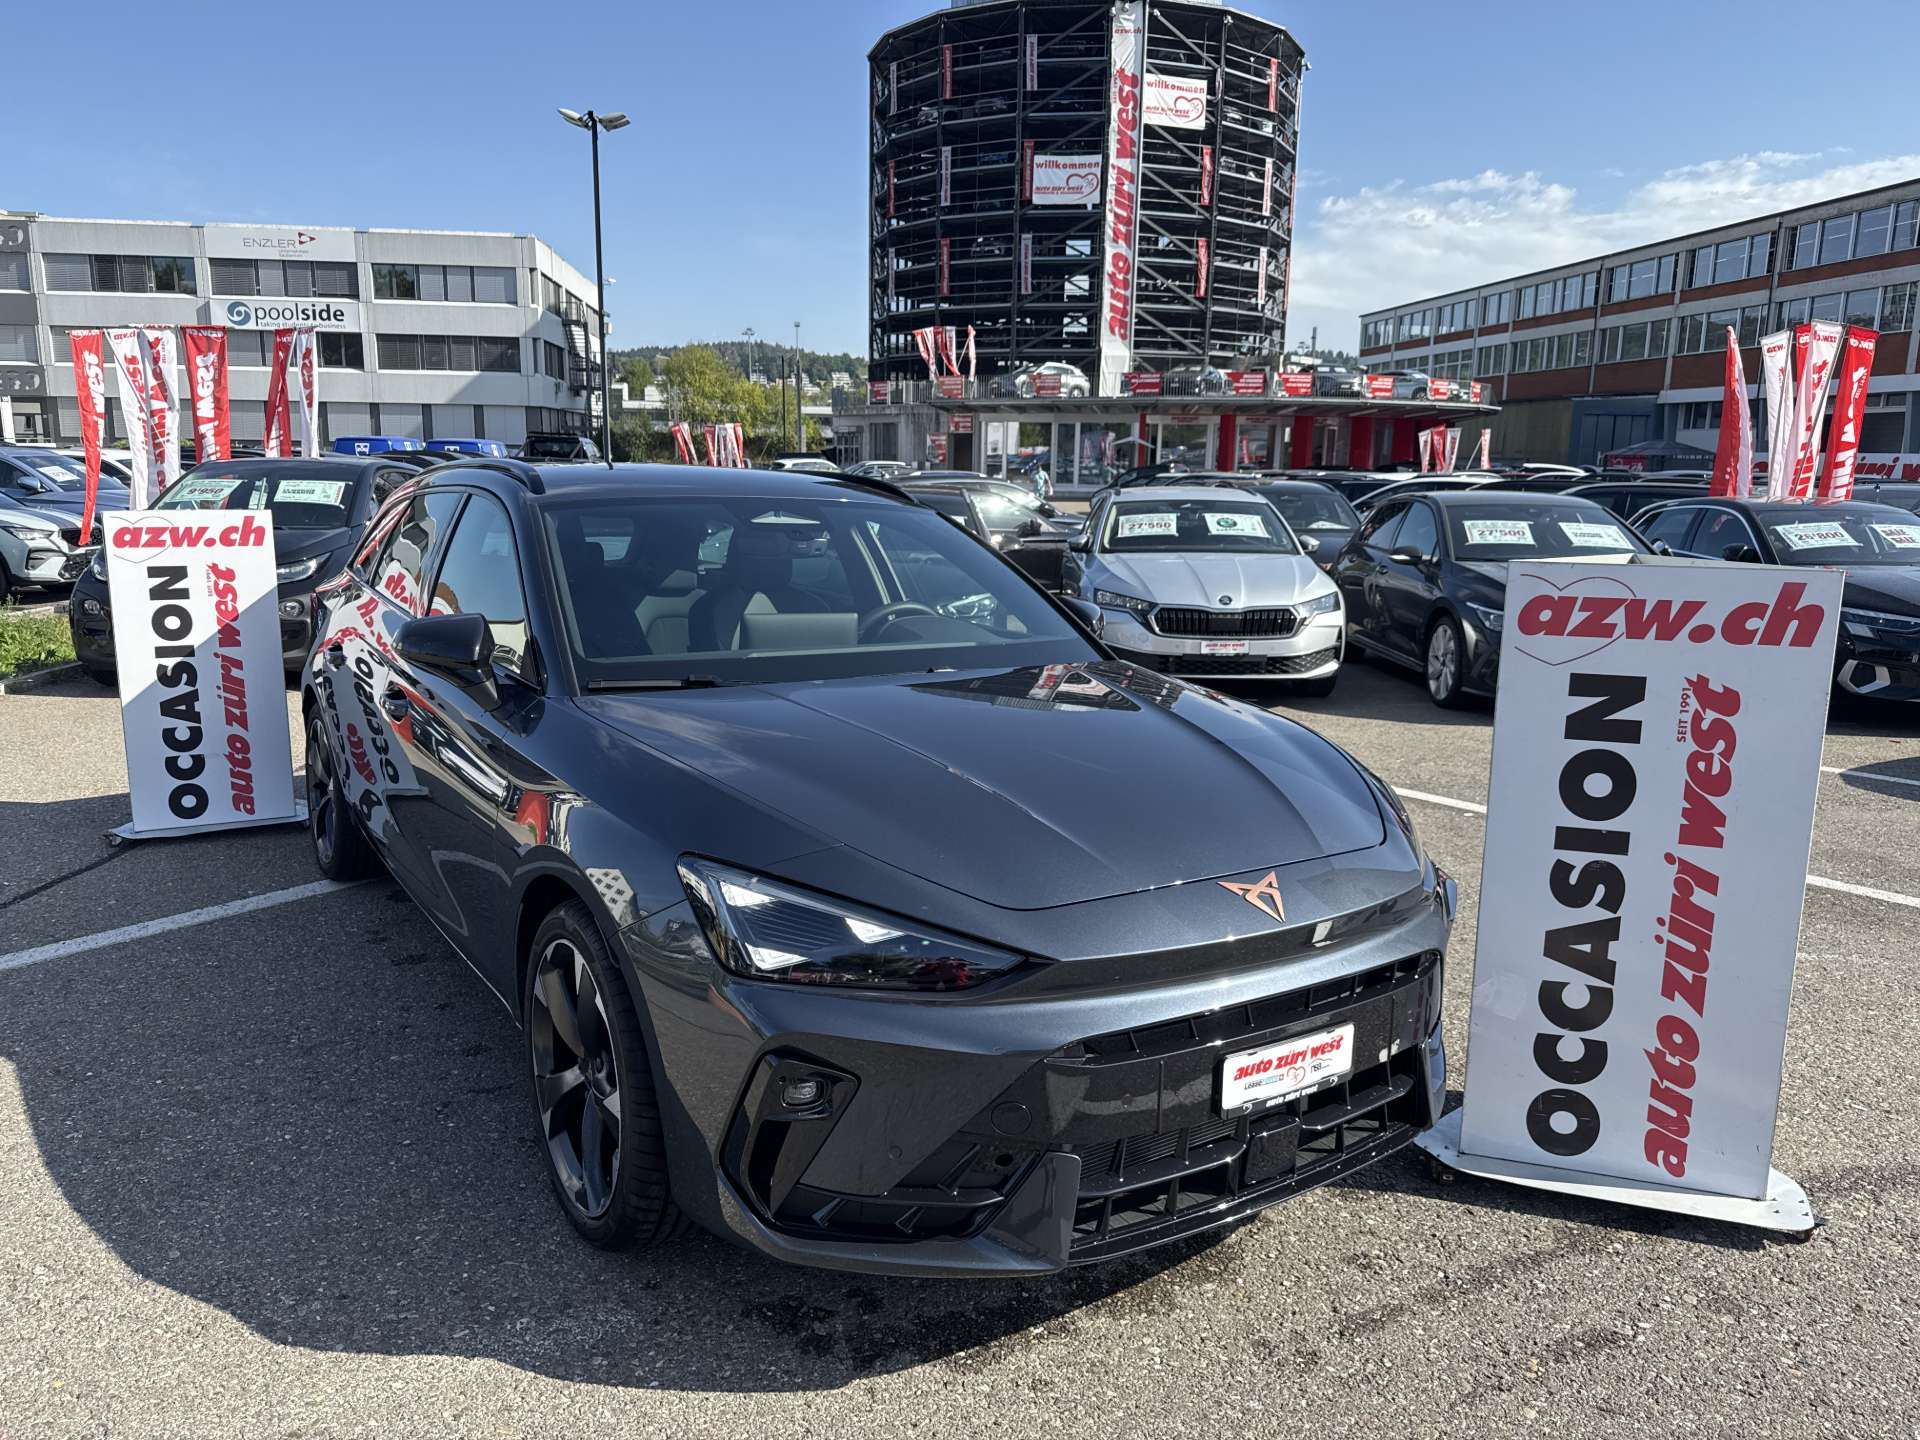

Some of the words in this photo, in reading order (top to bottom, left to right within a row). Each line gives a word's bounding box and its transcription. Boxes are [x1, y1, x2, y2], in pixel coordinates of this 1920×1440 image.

[1113, 68, 1140, 160] west
[1147, 80, 1205, 94] willkommen
[1035, 160, 1100, 169] willkommen
[242, 237, 296, 248] ENZLER
[1107, 163, 1136, 249] züri
[255, 303, 345, 326] poolside
[1107, 252, 1131, 341] auto
[112, 515, 266, 549] azw.ch
[1477, 528, 1526, 538] 27'500
[206, 562, 242, 648] west
[1517, 582, 1825, 648] azw.ch
[146, 565, 210, 820] OCCASION
[213, 651, 249, 733] züri
[1676, 719, 1688, 743] SEIT
[1679, 687, 1692, 714] 1991
[222, 733, 256, 816] auto
[1678, 673, 1741, 849] west
[1525, 672, 1647, 1157] OCCASION
[1654, 851, 1720, 1018] züri
[1234, 1058, 1274, 1080] auto
[1274, 1045, 1309, 1071] züri
[1310, 1034, 1344, 1059] west
[1642, 1014, 1700, 1178] auto
